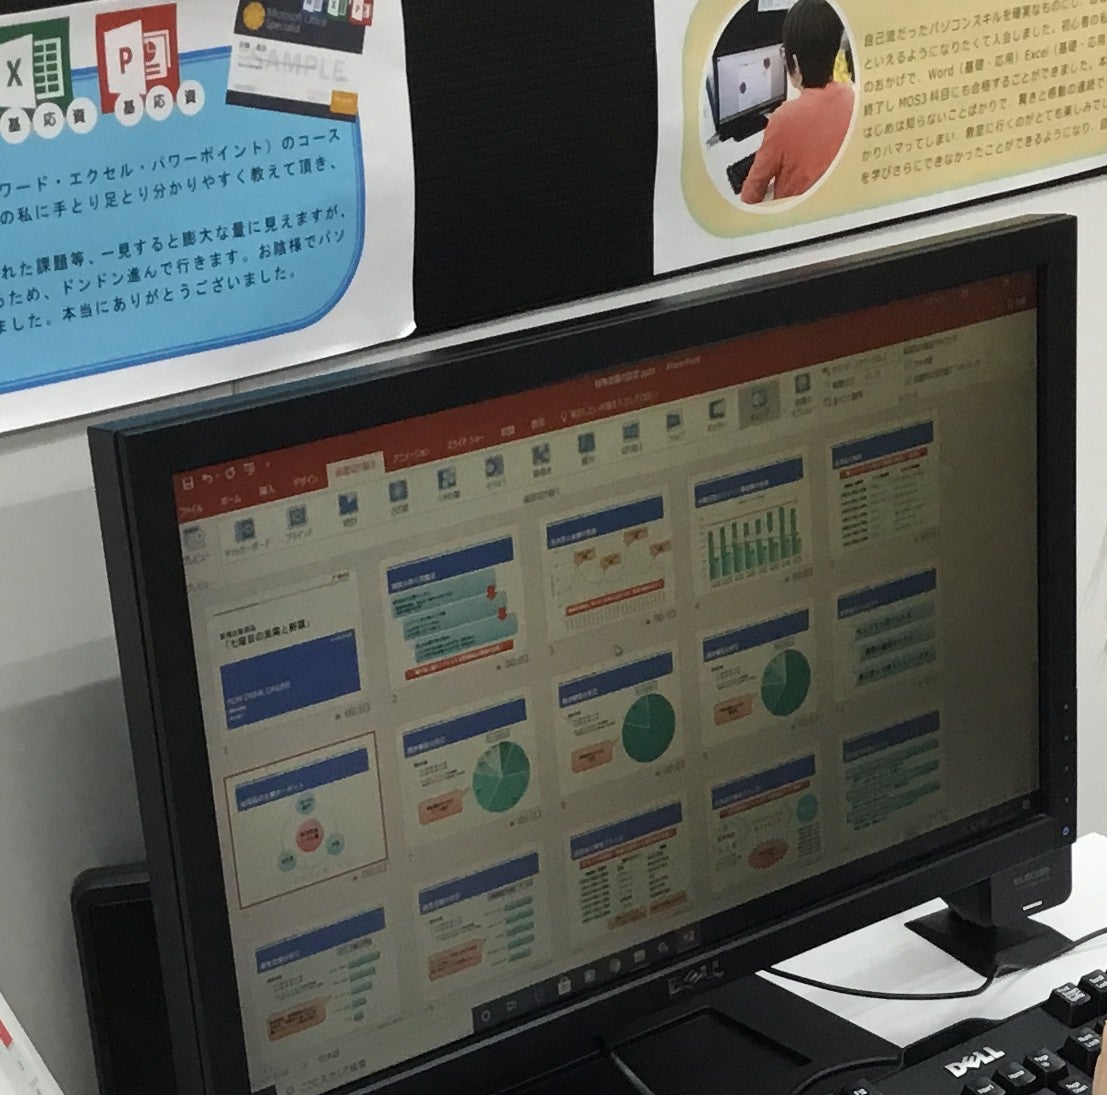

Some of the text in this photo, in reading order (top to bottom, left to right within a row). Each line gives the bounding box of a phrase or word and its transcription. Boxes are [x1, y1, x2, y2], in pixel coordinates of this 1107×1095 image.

[6, 58, 23, 87] X
[119, 46, 133, 74] P
[944, 1046, 1006, 1078] DELL
